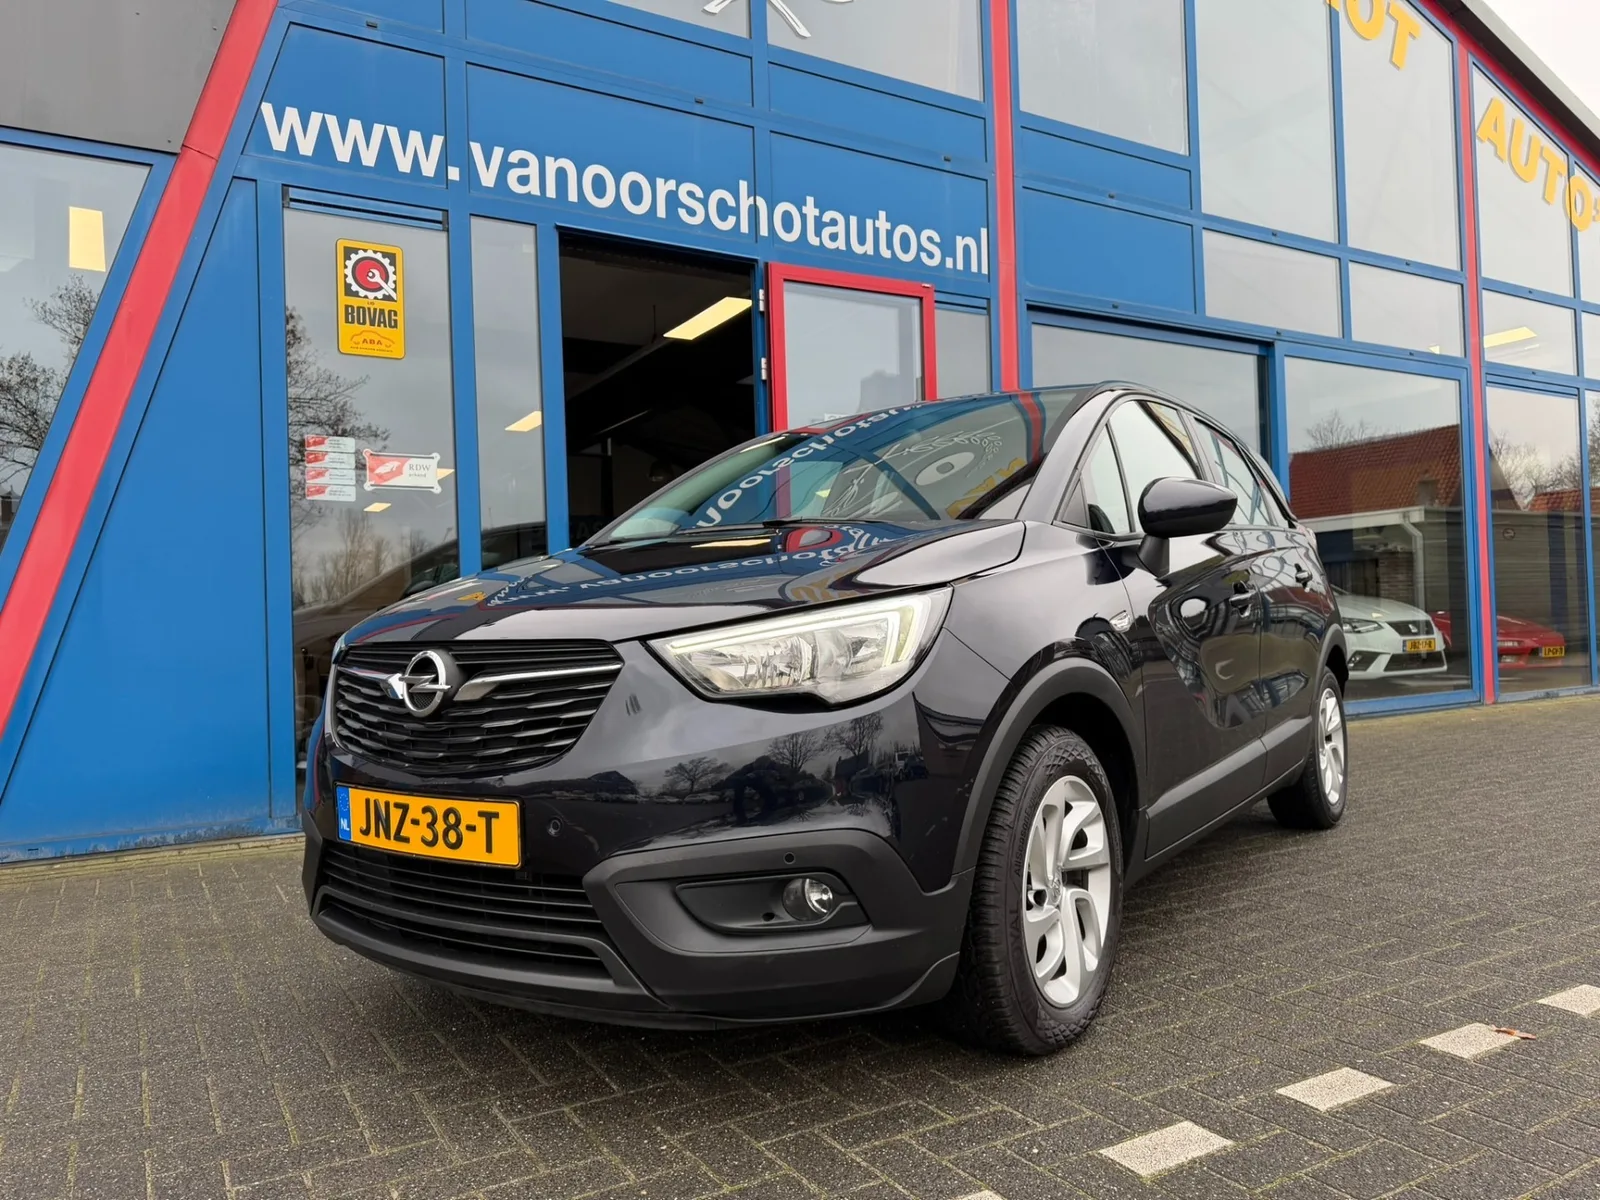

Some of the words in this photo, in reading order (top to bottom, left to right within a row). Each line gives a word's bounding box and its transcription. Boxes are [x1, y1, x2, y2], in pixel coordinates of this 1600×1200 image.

[1324, 0, 1421, 70] OT
[261, 101, 989, 276] www.vanoorschotautos.nl
[344, 304, 398, 329] BOVAG
[362, 338, 383, 346] ABA
[408, 463, 431, 471] RDW
[339, 817, 350, 831] NL
[359, 797, 500, 854] JNZ-38-T
